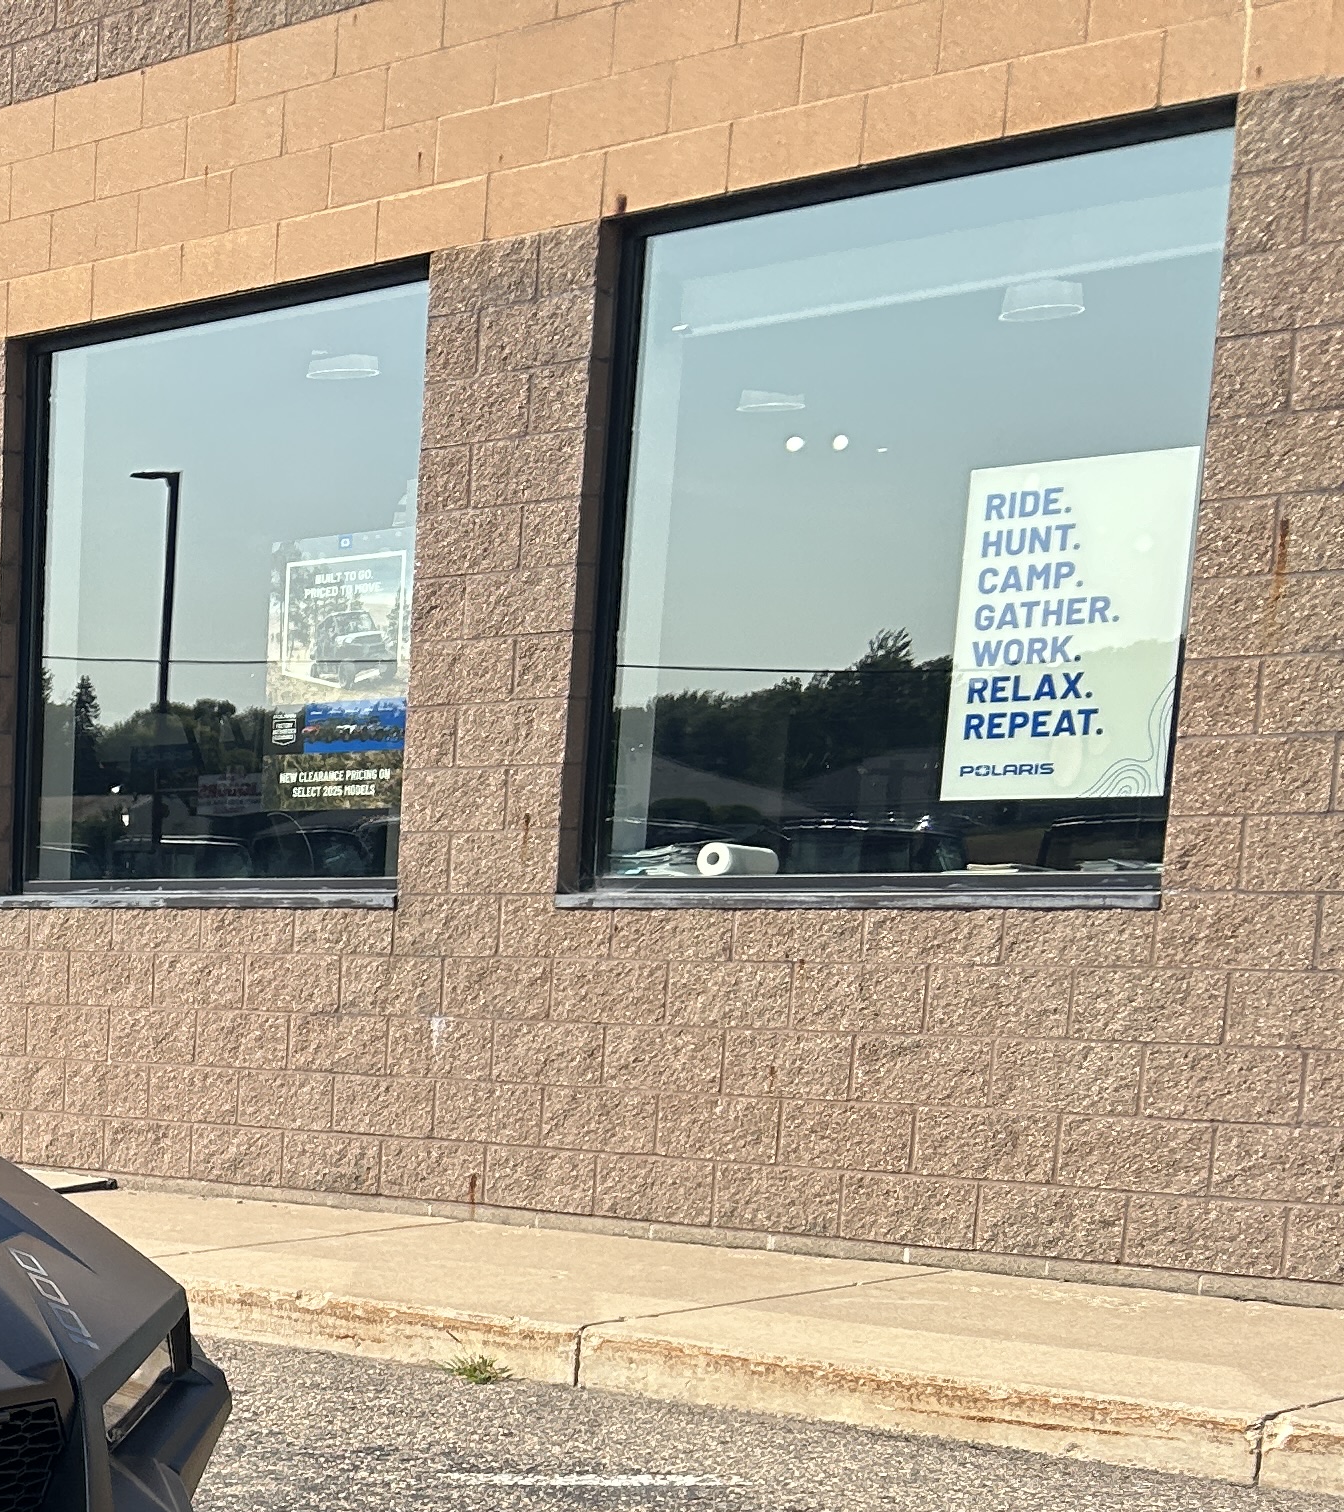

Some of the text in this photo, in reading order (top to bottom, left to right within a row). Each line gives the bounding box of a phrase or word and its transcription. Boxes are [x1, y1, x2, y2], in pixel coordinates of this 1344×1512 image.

[984, 486, 1072, 521] RIDE.
[980, 522, 1081, 558] HUNT.
[304, 586, 338, 599] PRICED
[340, 584, 353, 596] TO
[315, 569, 374, 584] BUILT TO GO.
[977, 560, 1084, 595] CAMP.
[973, 595, 1120, 631] GATHER.
[972, 634, 1082, 668] WORK.
[966, 671, 1094, 705] RELAX.
[962, 707, 1104, 740] REPEAT.
[279, 768, 391, 784] NEW CLEARANCE PRICING ON
[959, 762, 1055, 778] POLARIS
[292, 786, 322, 798] SELECT
[344, 784, 376, 796] MODELS
